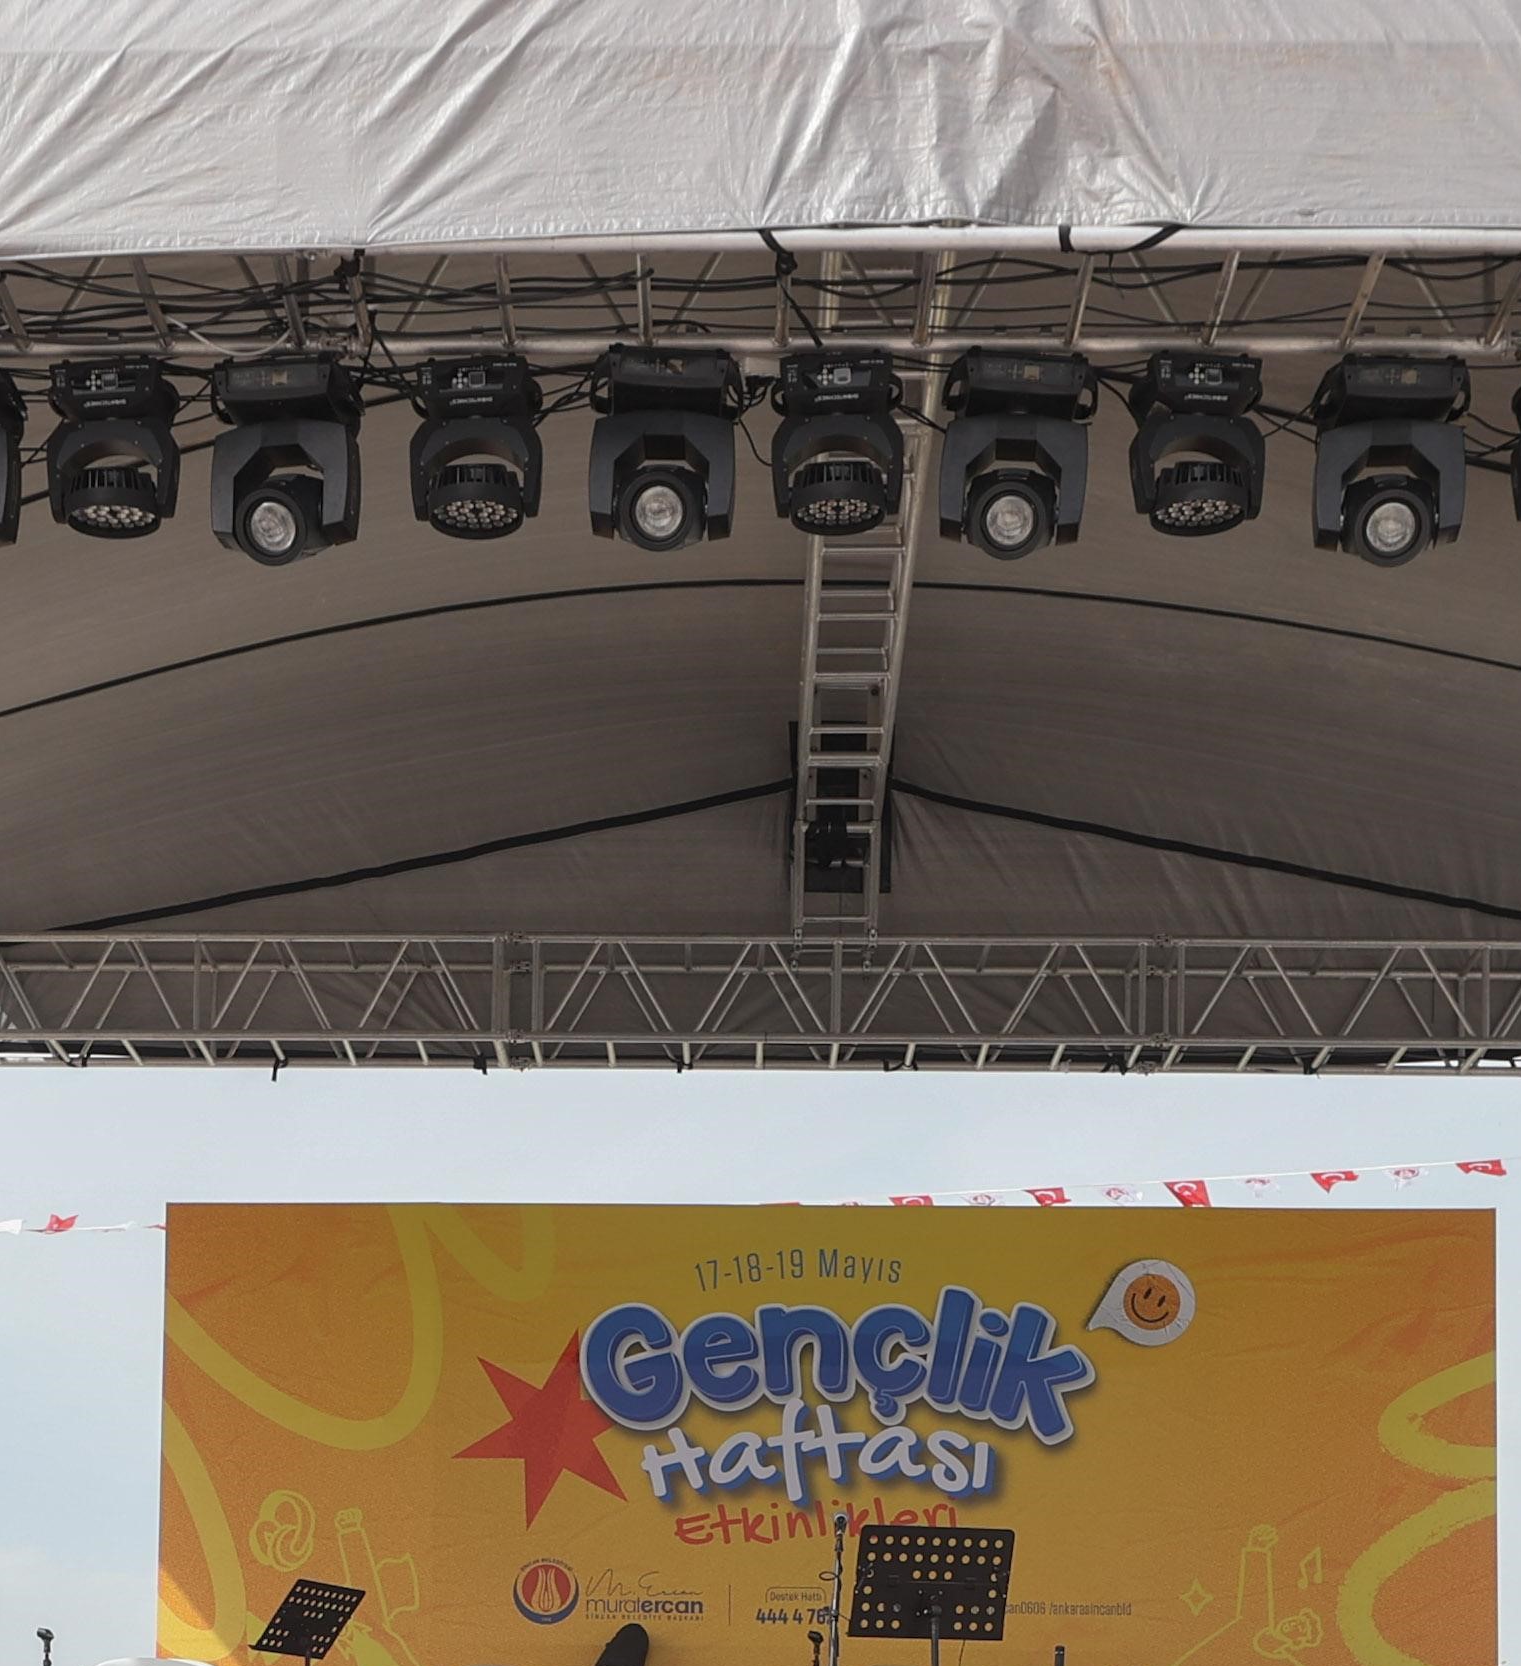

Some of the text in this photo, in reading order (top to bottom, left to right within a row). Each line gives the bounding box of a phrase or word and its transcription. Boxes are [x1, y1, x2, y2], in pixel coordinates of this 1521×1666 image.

[694, 1248, 903, 1292] 17-18-19 Mayıs
[582, 1286, 1094, 1443] Gençlik
[756, 1608, 788, 1624] 444
[792, 1608, 803, 1624] 4
